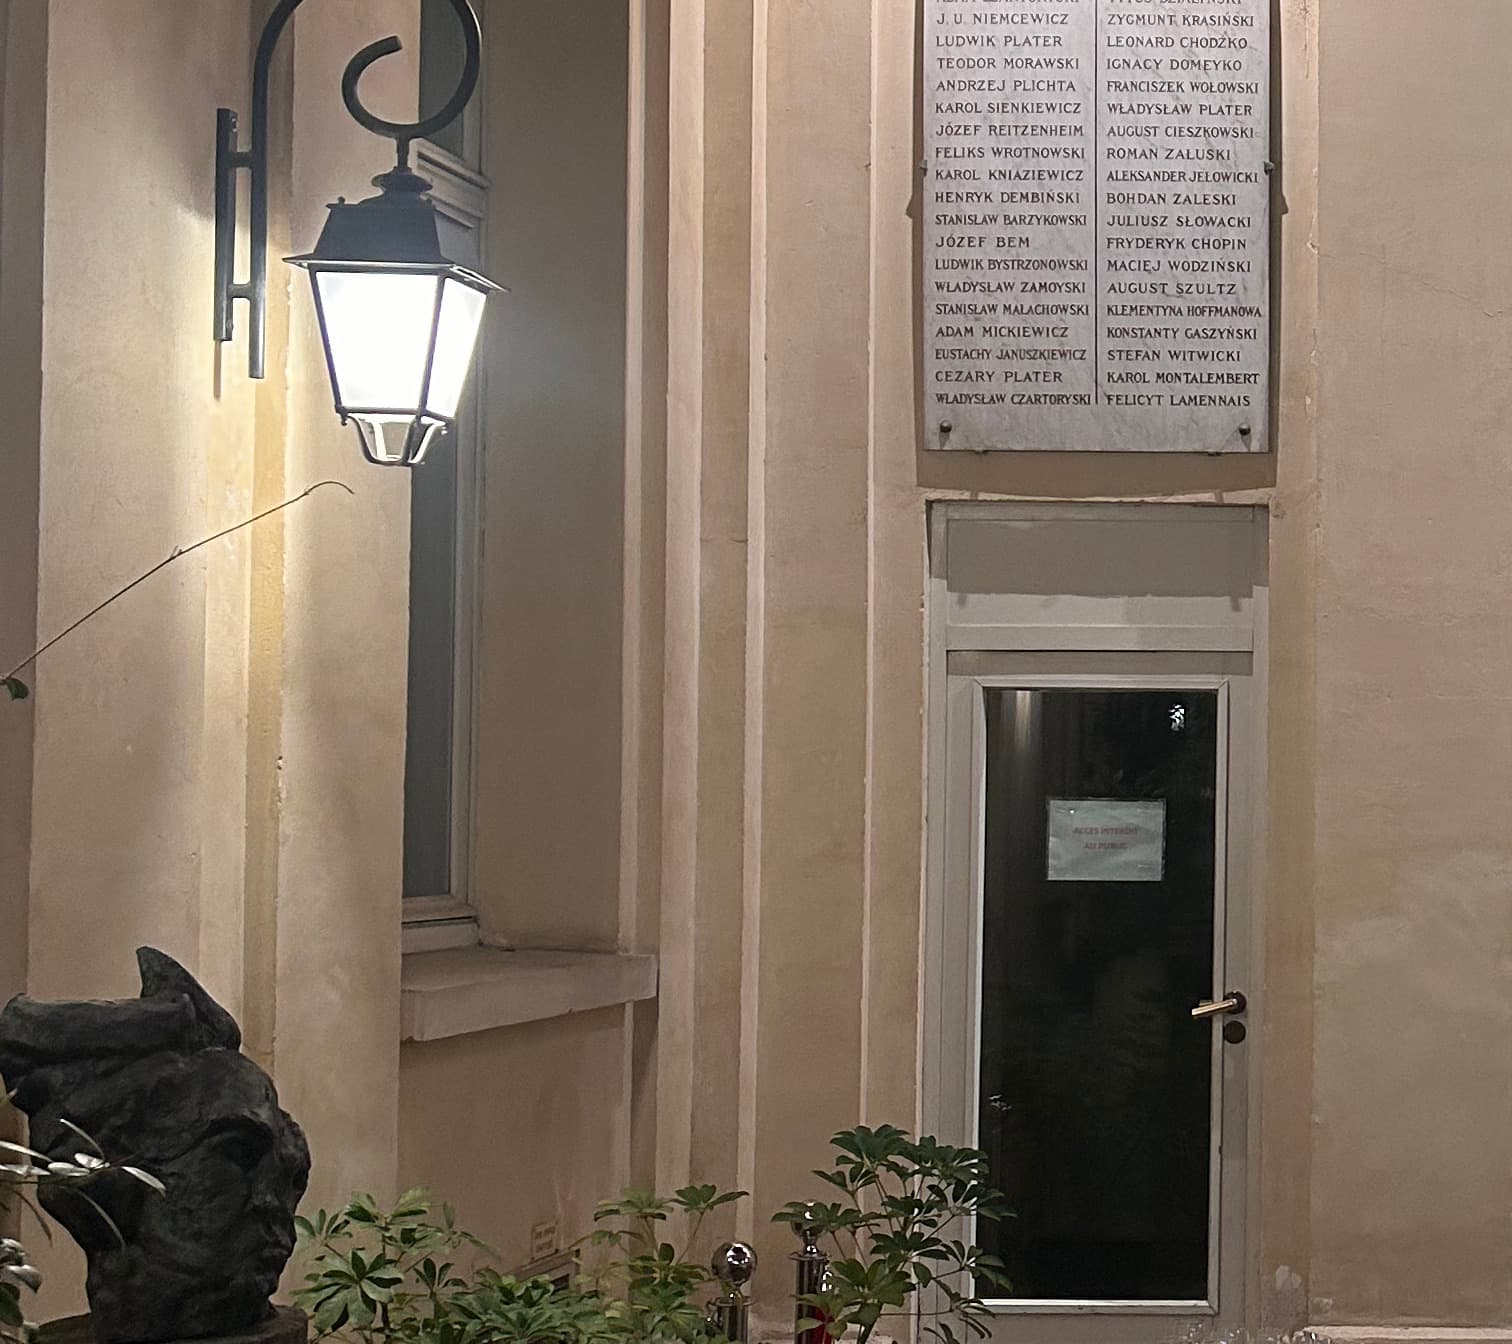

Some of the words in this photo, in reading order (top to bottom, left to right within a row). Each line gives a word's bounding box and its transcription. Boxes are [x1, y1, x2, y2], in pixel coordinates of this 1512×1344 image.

[971, 12, 1069, 25] NIEMCEWICZ
[1106, 12, 1177, 27] ZYGMUNT
[1181, 10, 1254, 28] KRASIŃSKI
[935, 34, 997, 48] LUDWIK
[1003, 35, 1063, 48] PLATER
[1106, 35, 1175, 50] LEONARD
[935, 57, 997, 70] TEODOR
[1002, 57, 1080, 70] MORAWSKI
[1106, 58, 1163, 72] IGNACY
[1169, 58, 1243, 73] DOMEYKO
[935, 79, 1006, 93] ANDRZEJ
[1013, 79, 1077, 93] PLICHTA
[1106, 79, 1186, 94] FRANCISZEK
[935, 101, 982, 114] KAROL
[986, 101, 1082, 115] SIENKIEWICZ
[1198, 103, 1253, 118] PLATER
[935, 121, 983, 137] JÓZEF
[987, 124, 1085, 137] REITZENHEIM
[1106, 124, 1161, 139] AUGUST
[1164, 125, 1255, 139] CIESZKOWSKI
[935, 146, 985, 159] FELIKS
[990, 146, 1087, 160] WROTNOWSKI
[1106, 147, 1159, 161] ROMAN
[935, 169, 982, 181] KAROL
[988, 169, 1084, 182] KNIAZIEWICZ
[1106, 169, 1186, 184] ALEKSANDER
[935, 191, 994, 204] HENRYK
[999, 189, 1080, 205] DEMBIŃSKI
[1106, 191, 1169, 206] BOHDAN
[1172, 192, 1237, 207] ZALESKI
[1002, 214, 1088, 227] BARZYKOWSKI
[1106, 214, 1169, 228] JULIUSZ
[935, 232, 987, 249] JÓZEF
[996, 235, 1030, 249] BEM
[1106, 236, 1186, 251] FRYDERYK
[1190, 237, 1248, 252] CHOPIN
[934, 258, 985, 271] LUDWIK
[987, 258, 1089, 271] BYSTRZONOWSKI
[1167, 256, 1251, 274] WODZIŃSKI
[1019, 281, 1086, 294] ZAMOYSKI
[1107, 281, 1168, 296] AUGUST
[1176, 281, 1238, 297] SZULTZ
[1106, 304, 1184, 318] KLEMENTYNA
[1186, 304, 1263, 319] HOFFMANOWA
[935, 325, 975, 338] ADAM
[981, 325, 1070, 338] MICKIEWICZ
[1106, 326, 1180, 340] KONSTANTY
[1183, 325, 1257, 341] GASZYŃSKI
[934, 348, 992, 361] EUSTACHY
[995, 348, 1087, 361] JANUSZKIEWICZ
[1107, 348, 1161, 362] STEFAN
[1167, 349, 1241, 363] WITWICKI
[934, 370, 995, 383] CEZARY
[1003, 370, 1065, 383] PLATER
[1106, 371, 1151, 384] KAROL
[1154, 371, 1261, 386] MONTALEMBERT
[1010, 393, 1092, 406] CZARTORYSKI
[1106, 393, 1165, 407] FELICYT
[1169, 393, 1251, 408] LAMENNAIS
